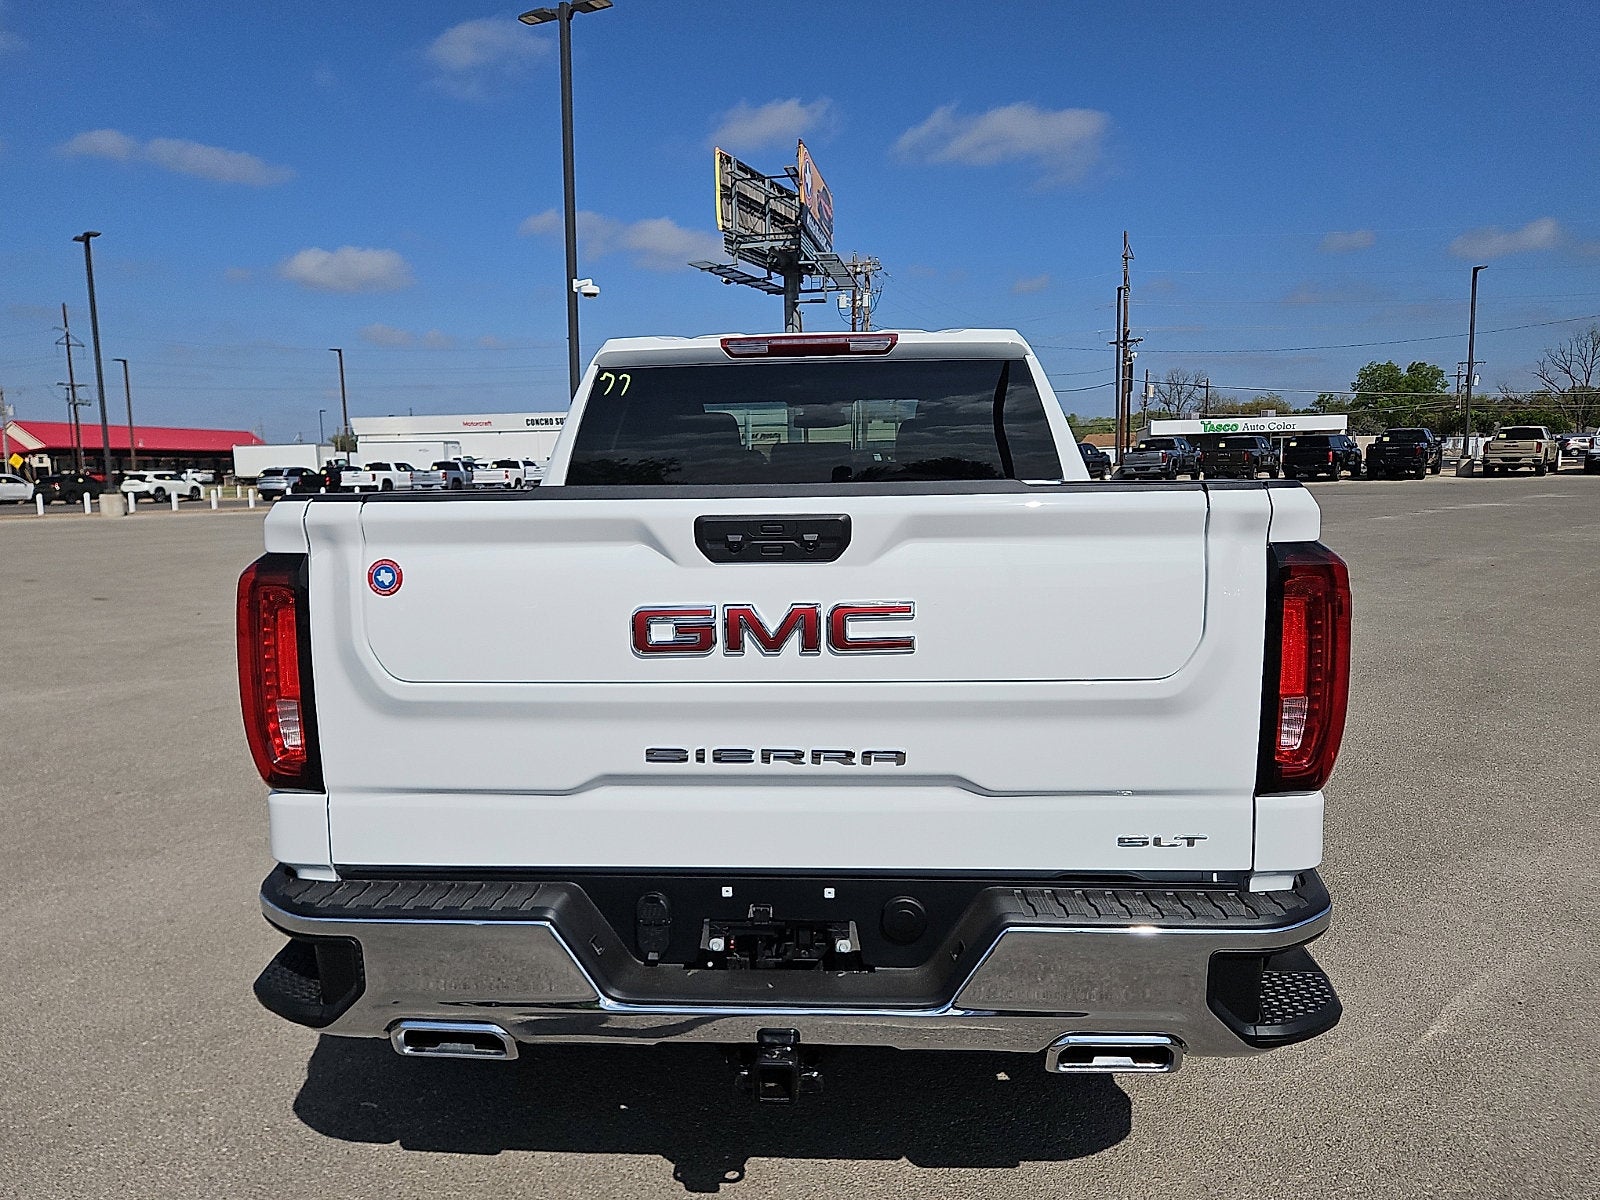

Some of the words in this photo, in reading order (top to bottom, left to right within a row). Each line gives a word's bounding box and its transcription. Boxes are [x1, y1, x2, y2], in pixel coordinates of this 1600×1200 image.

[600, 372, 631, 396] 77
[525, 417, 554, 427] CONCHO
[554, 416, 567, 426] SU
[1200, 420, 1239, 433] TASCO
[1242, 422, 1266, 432] Auto
[1268, 421, 1296, 431] Color
[630, 600, 916, 658] GMC
[645, 748, 907, 767] SIERRA
[1116, 834, 1208, 848] SLT
